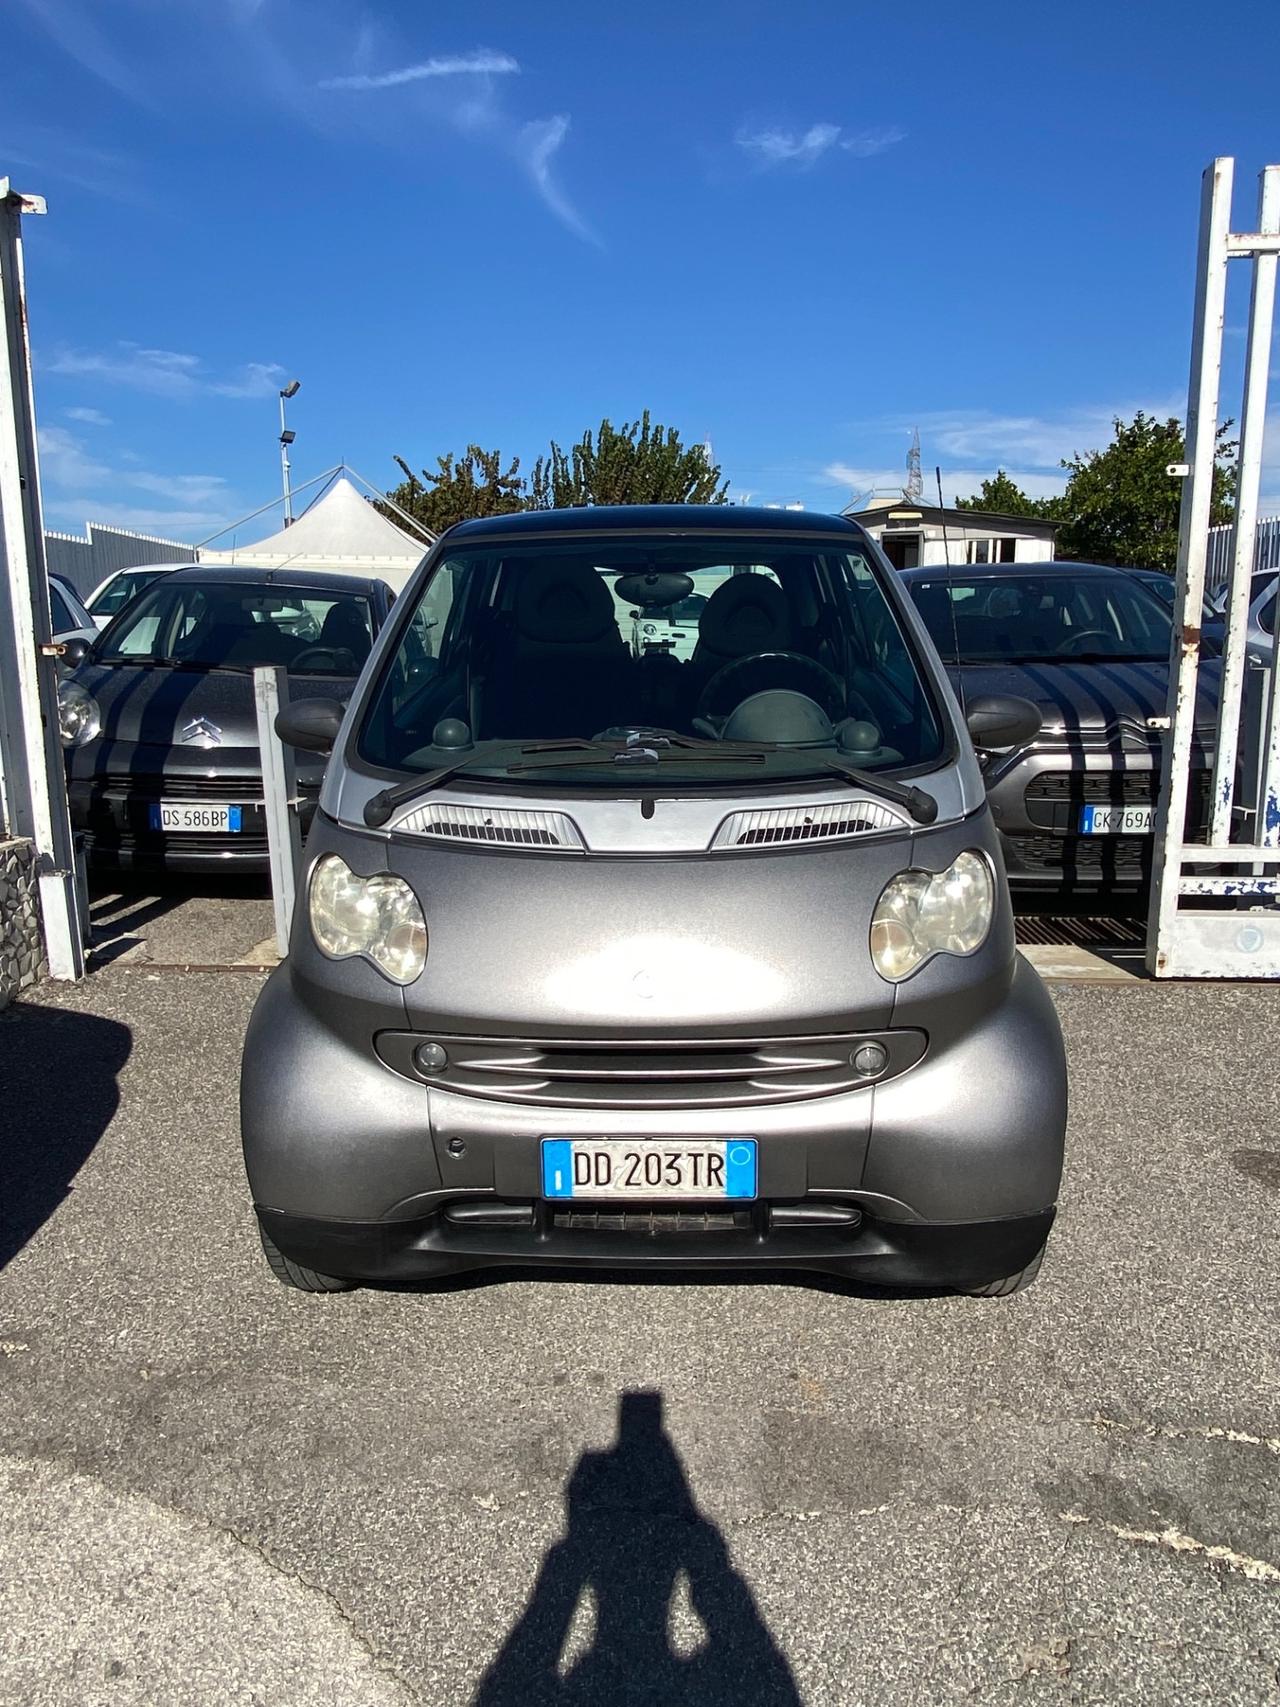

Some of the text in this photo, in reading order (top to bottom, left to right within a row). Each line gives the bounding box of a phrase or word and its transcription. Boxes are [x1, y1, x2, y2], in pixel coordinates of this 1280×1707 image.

[162, 810, 228, 827] DS 586BP
[1094, 811, 1111, 828] GK
[574, 1152, 724, 1187] DD 203TR
